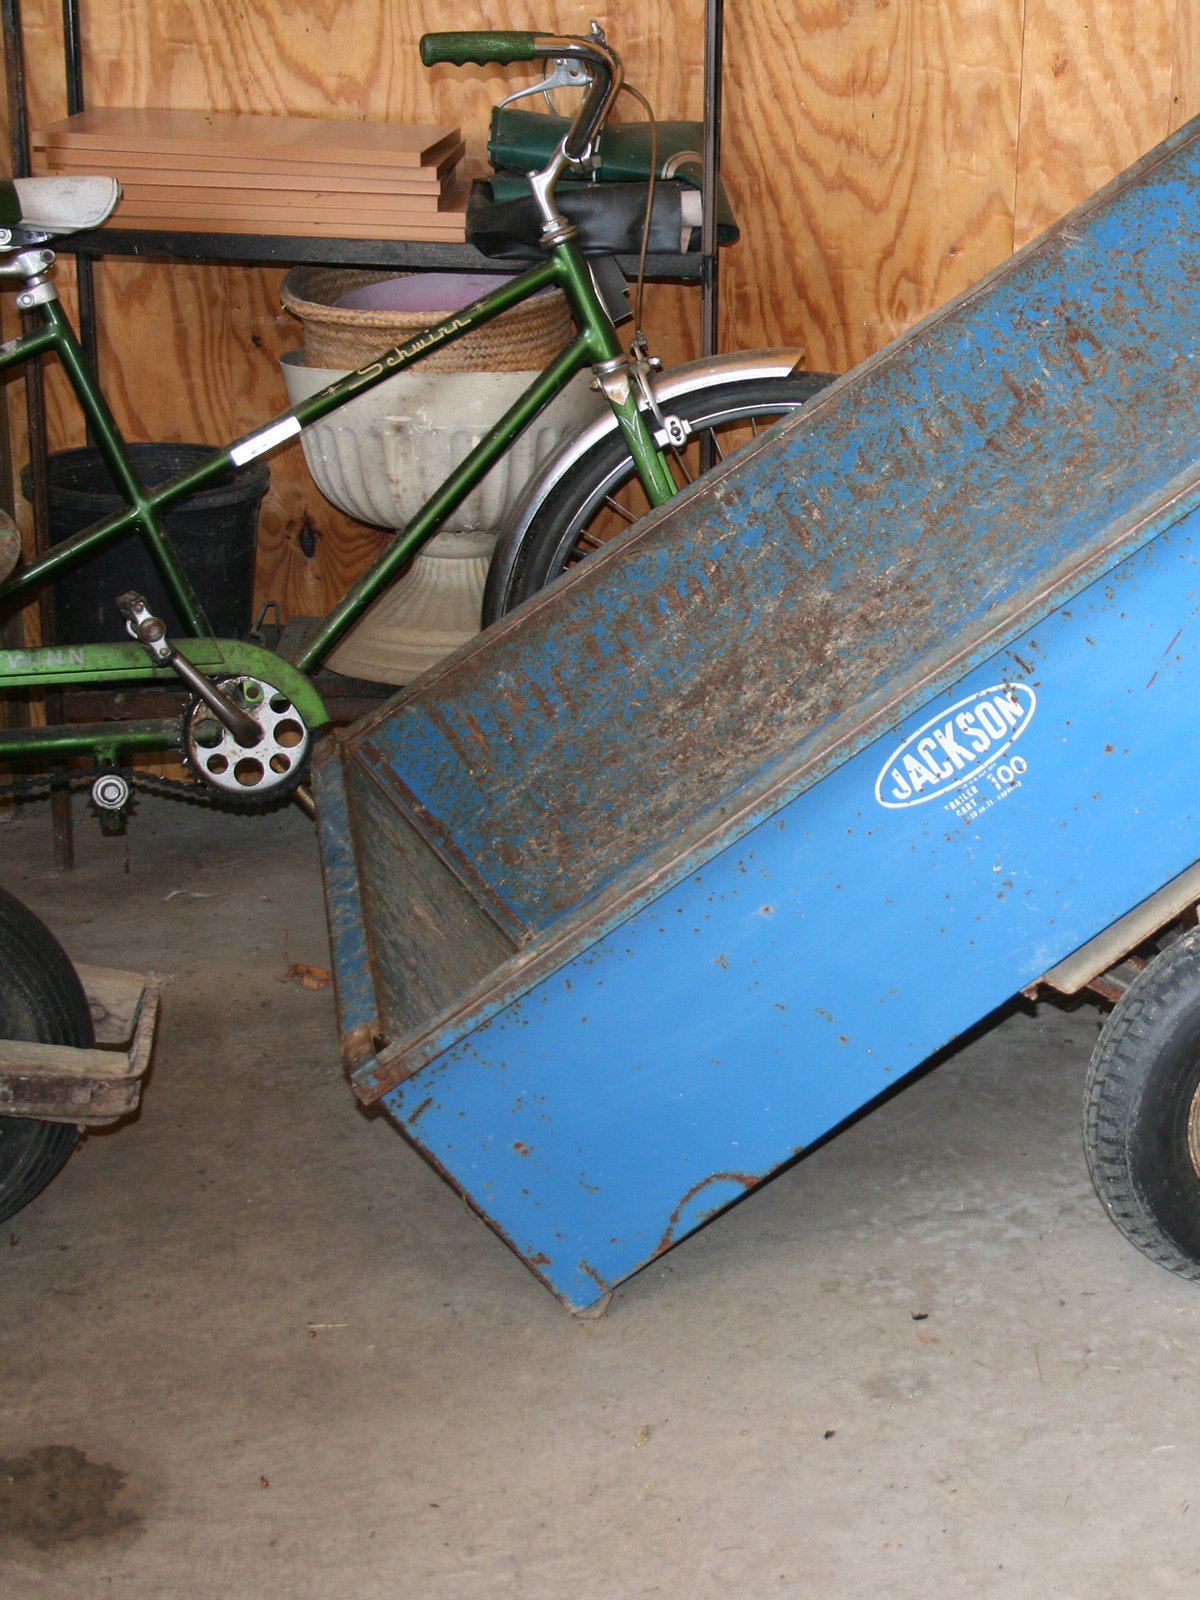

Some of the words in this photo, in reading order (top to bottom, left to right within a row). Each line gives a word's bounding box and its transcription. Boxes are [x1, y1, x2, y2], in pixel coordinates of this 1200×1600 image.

[349, 317, 472, 391] Schwinn
[891, 691, 1026, 800] JACKSON
[986, 755, 1028, 790] 100
[944, 786, 979, 811] TRAILER
[956, 798, 977, 817] CART
